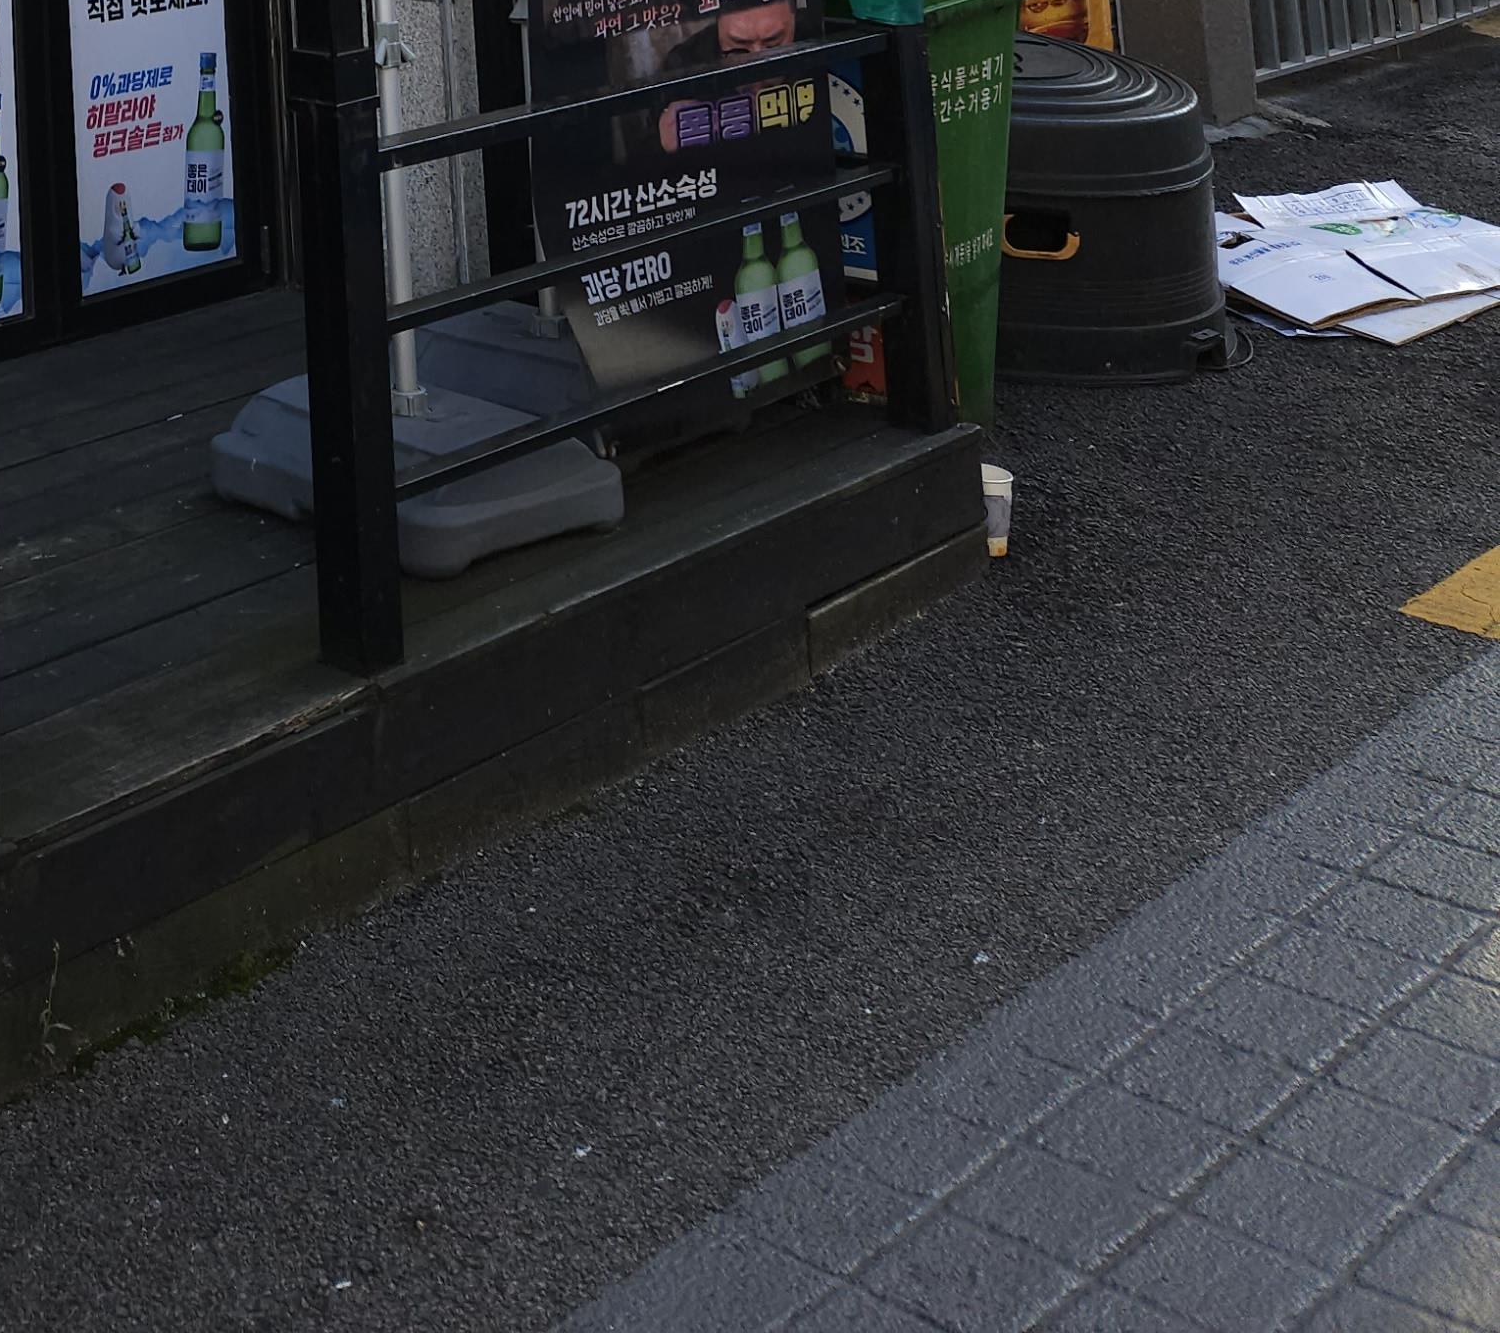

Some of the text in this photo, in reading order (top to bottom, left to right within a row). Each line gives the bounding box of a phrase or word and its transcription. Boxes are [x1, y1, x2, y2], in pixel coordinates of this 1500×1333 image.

[627, 13, 640, 31] 그
[89, 62, 174, 99] 0%과당제로
[85, 95, 156, 132] 히말라야
[933, 82, 1003, 124] 간수거용기
[92, 122, 161, 159] 핑크솔트
[565, 168, 718, 229] 72시간 산소숙성
[571, 224, 626, 252] 산소숙성으로
[581, 251, 672, 305] 과당 ZERO
